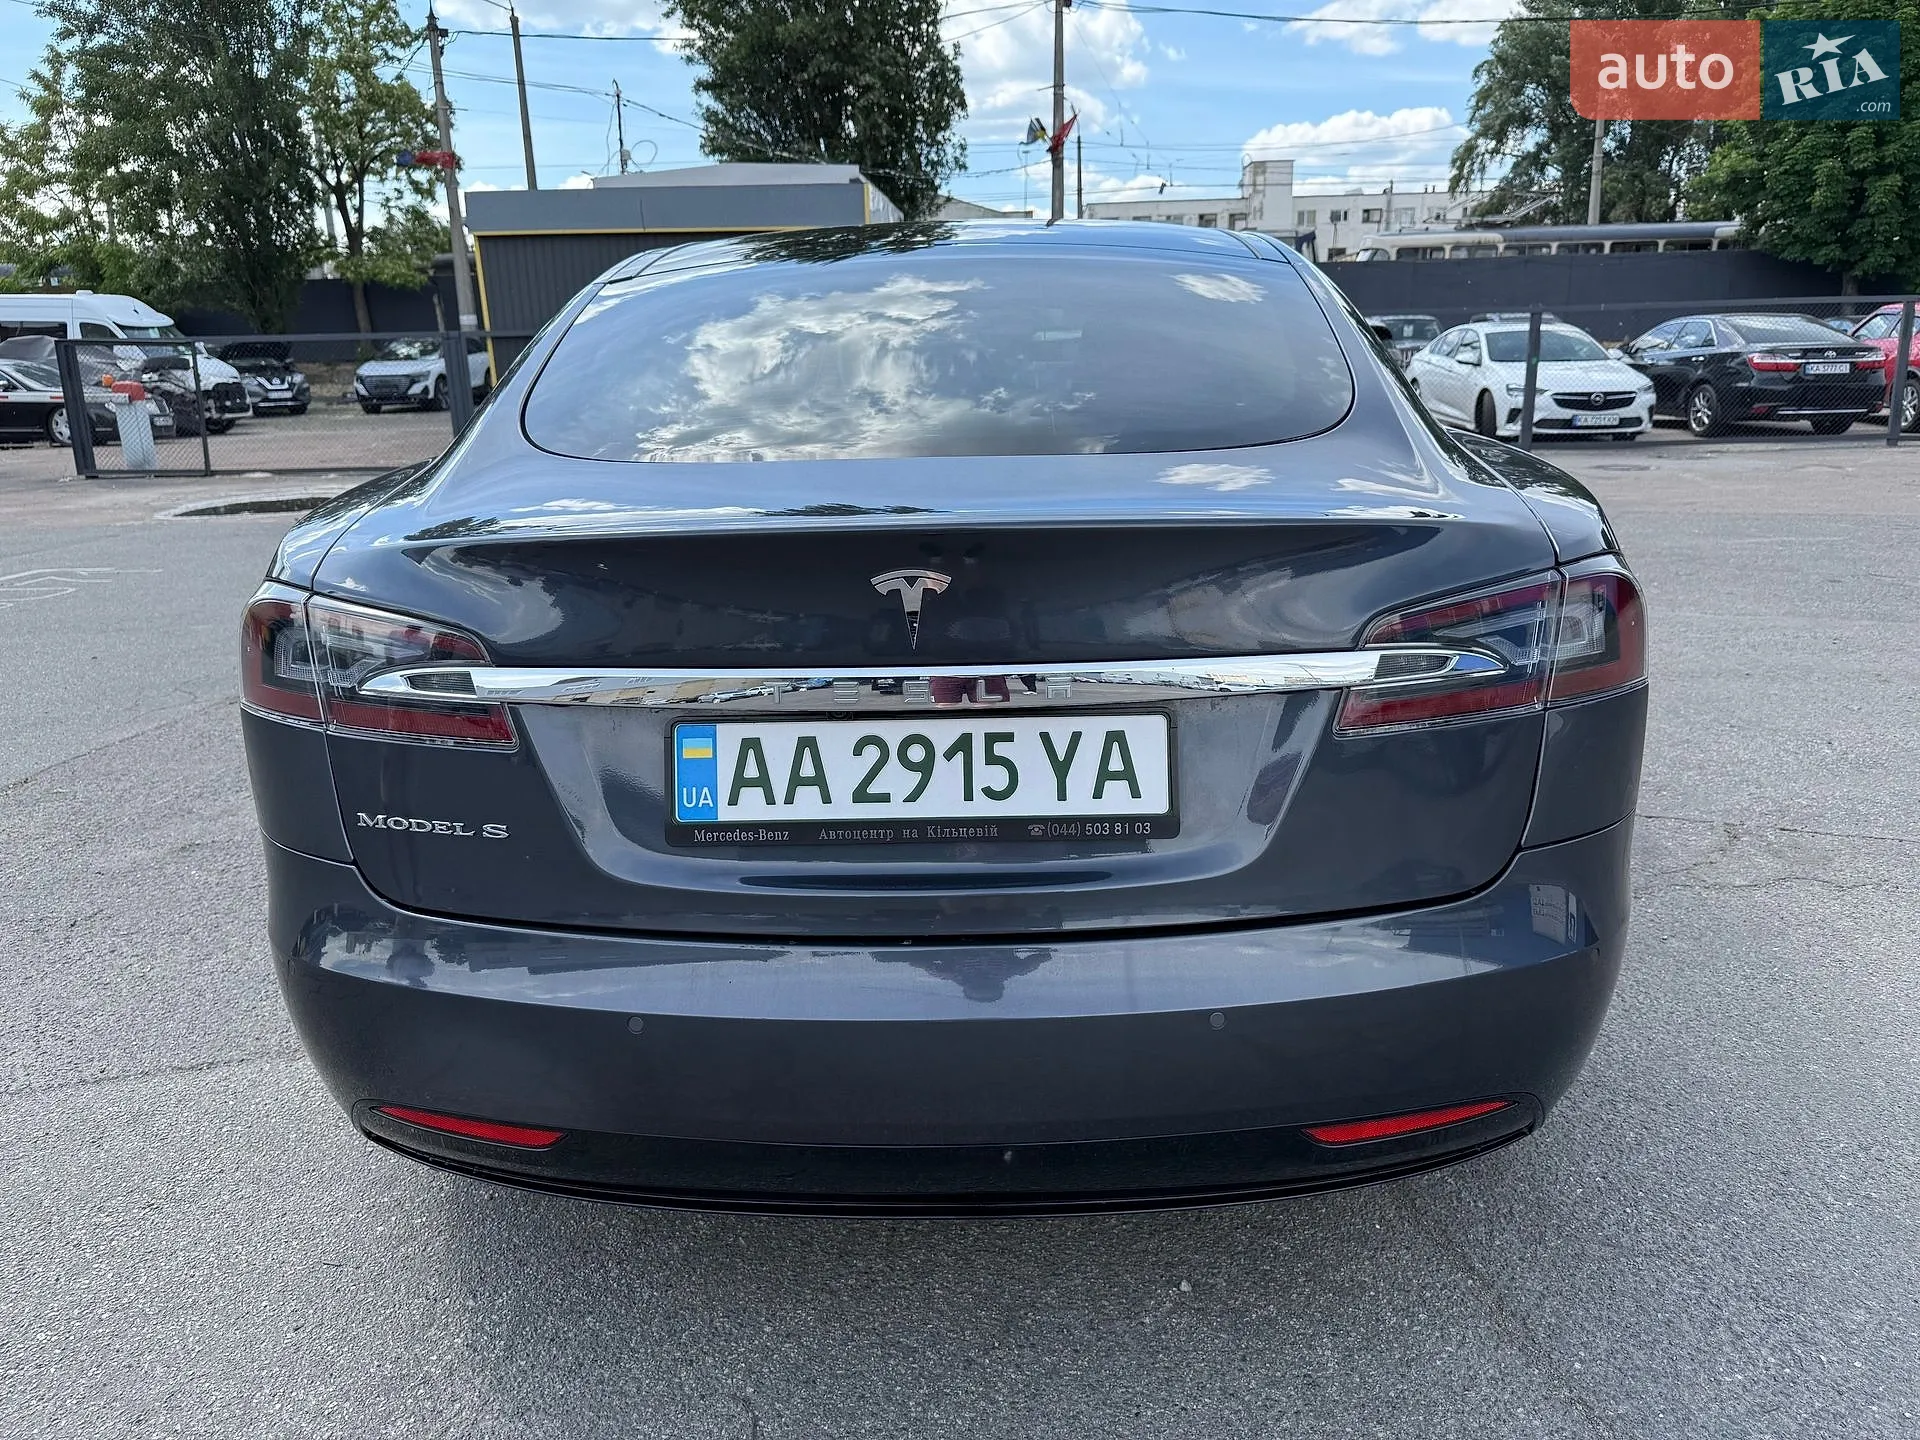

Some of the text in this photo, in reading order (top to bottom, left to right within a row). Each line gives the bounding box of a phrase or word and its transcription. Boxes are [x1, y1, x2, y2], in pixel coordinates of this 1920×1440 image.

[762, 676, 1072, 705] TESLA
[727, 730, 1142, 806] AA 2915 YA
[682, 786, 714, 808] UA
[357, 812, 510, 840] MODEL S
[693, 821, 1152, 842] Mercedes-Benz Автоцентр на Кільцевій (044) 503 81 03
